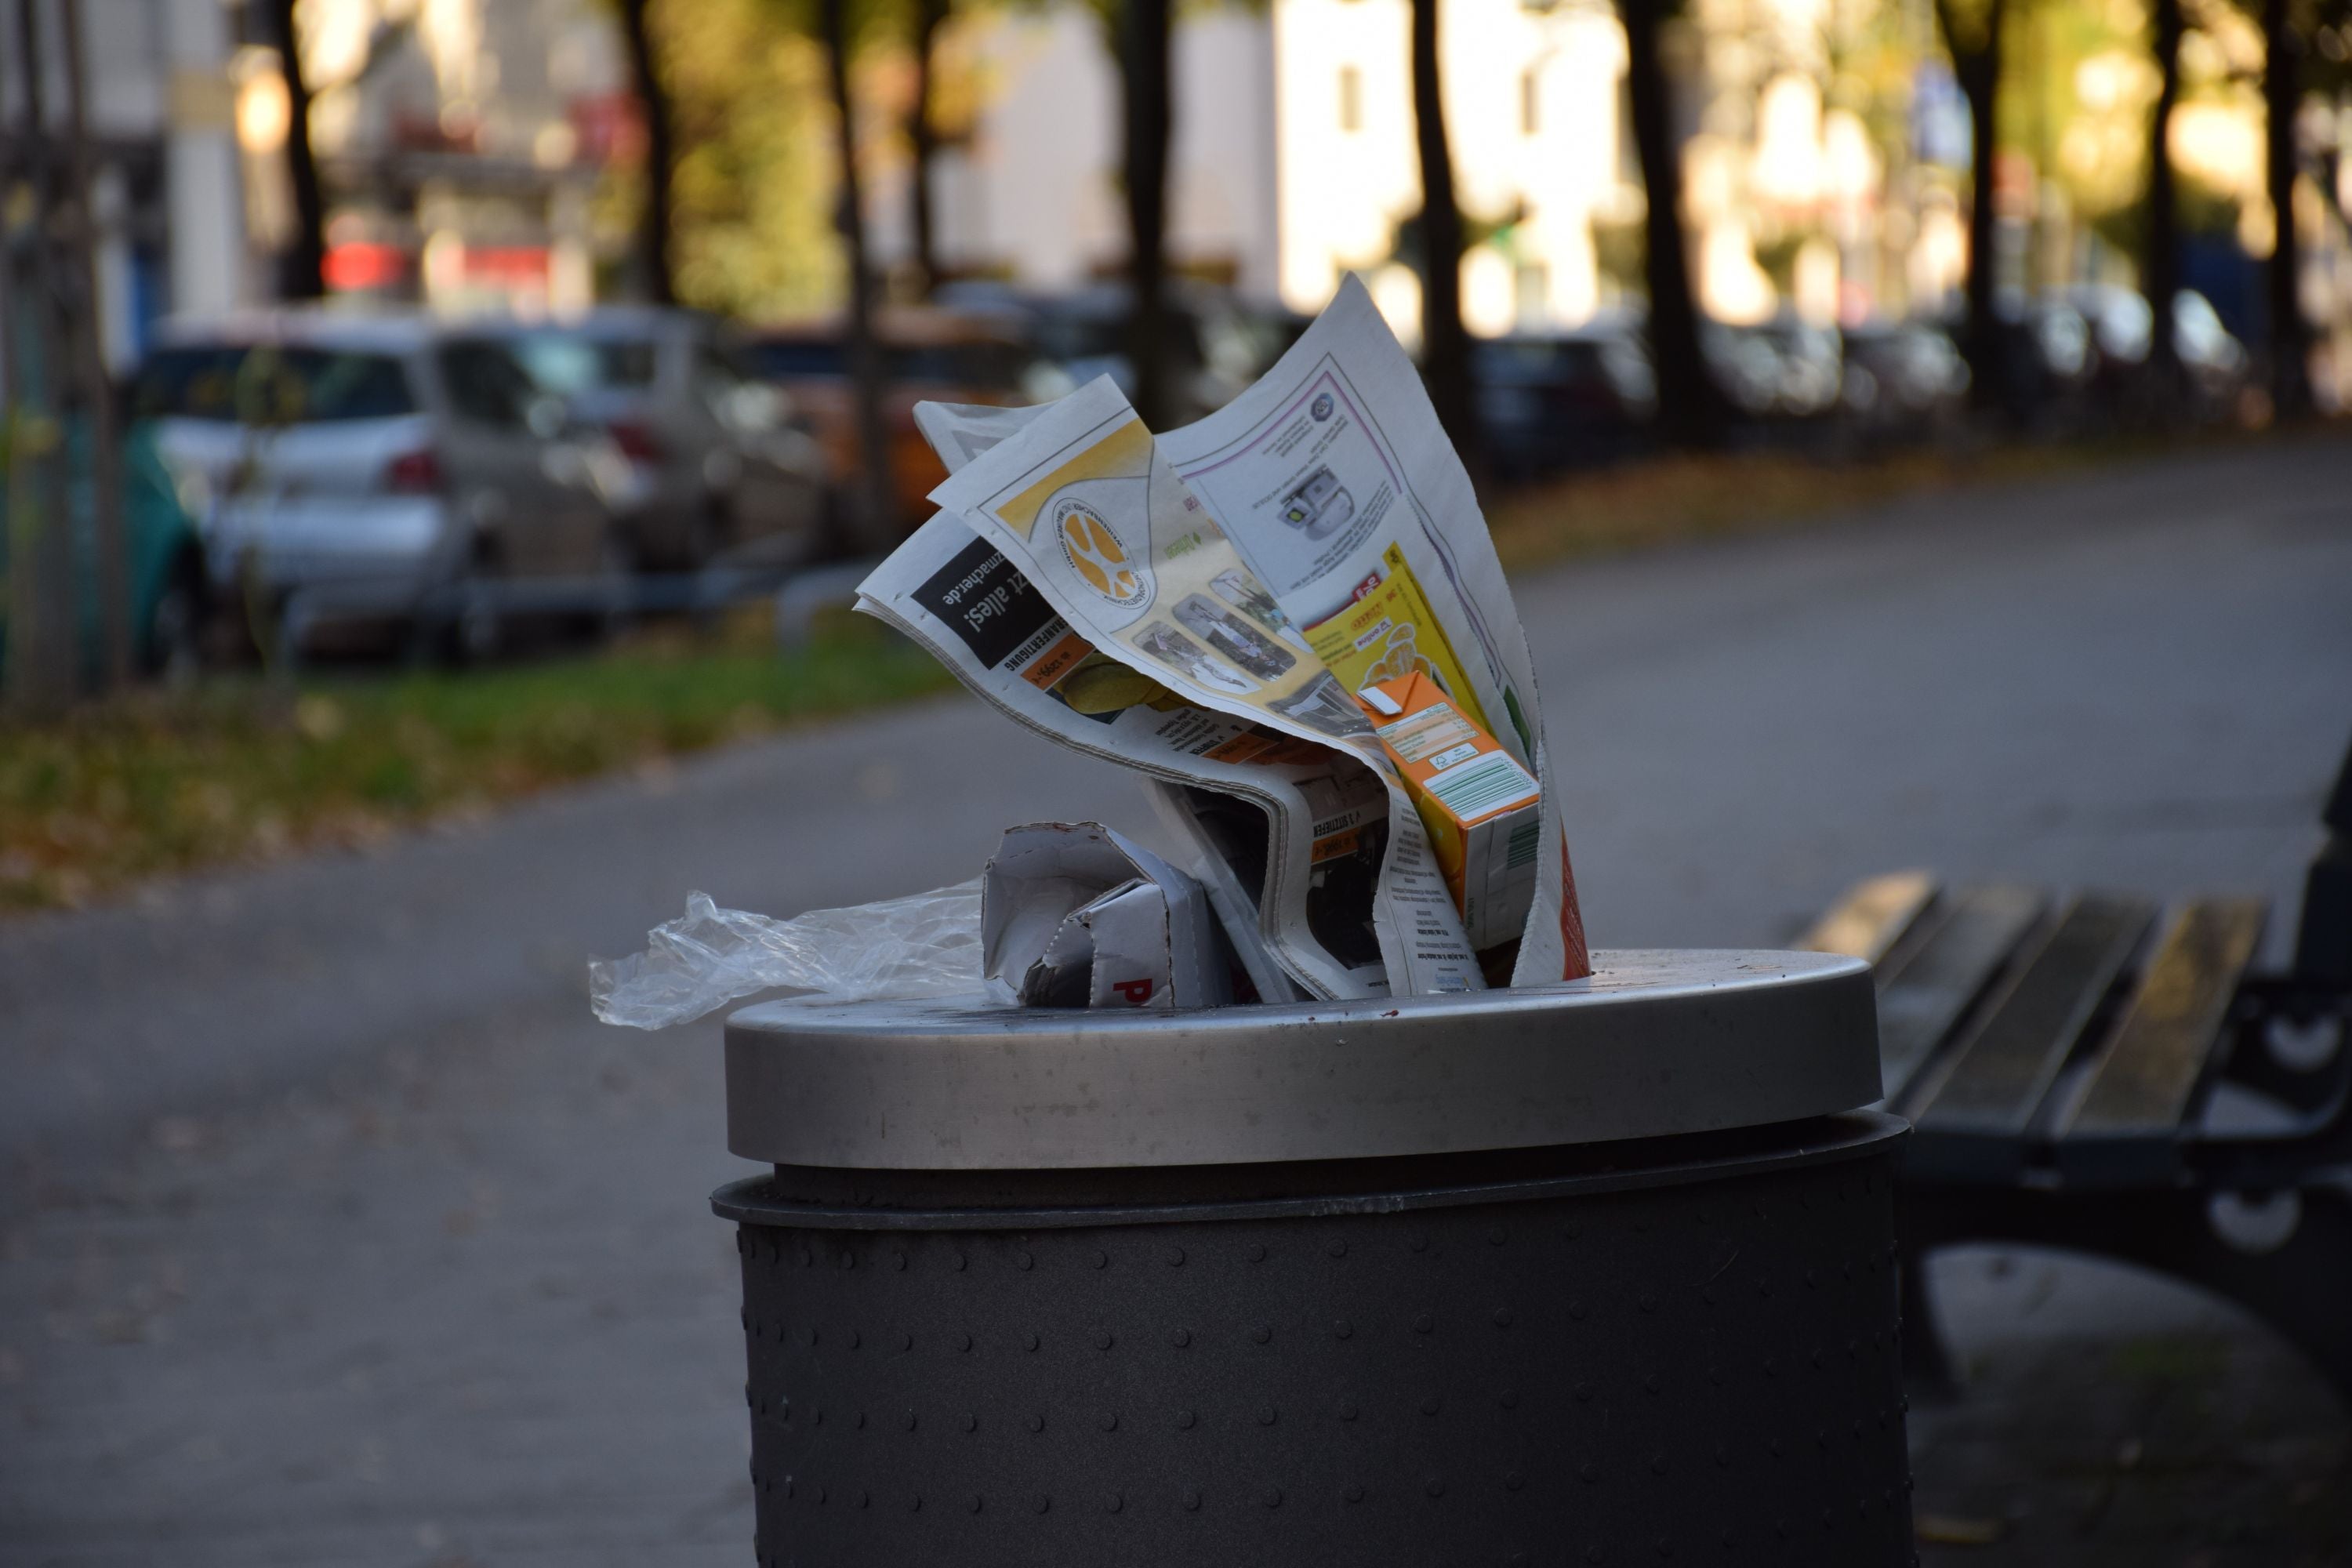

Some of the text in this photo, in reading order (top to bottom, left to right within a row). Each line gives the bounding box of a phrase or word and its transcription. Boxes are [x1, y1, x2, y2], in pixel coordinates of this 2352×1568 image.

[943, 550, 1006, 604] zmacher.de
[964, 586, 1010, 633] alles!
[1357, 629, 1379, 646] online
